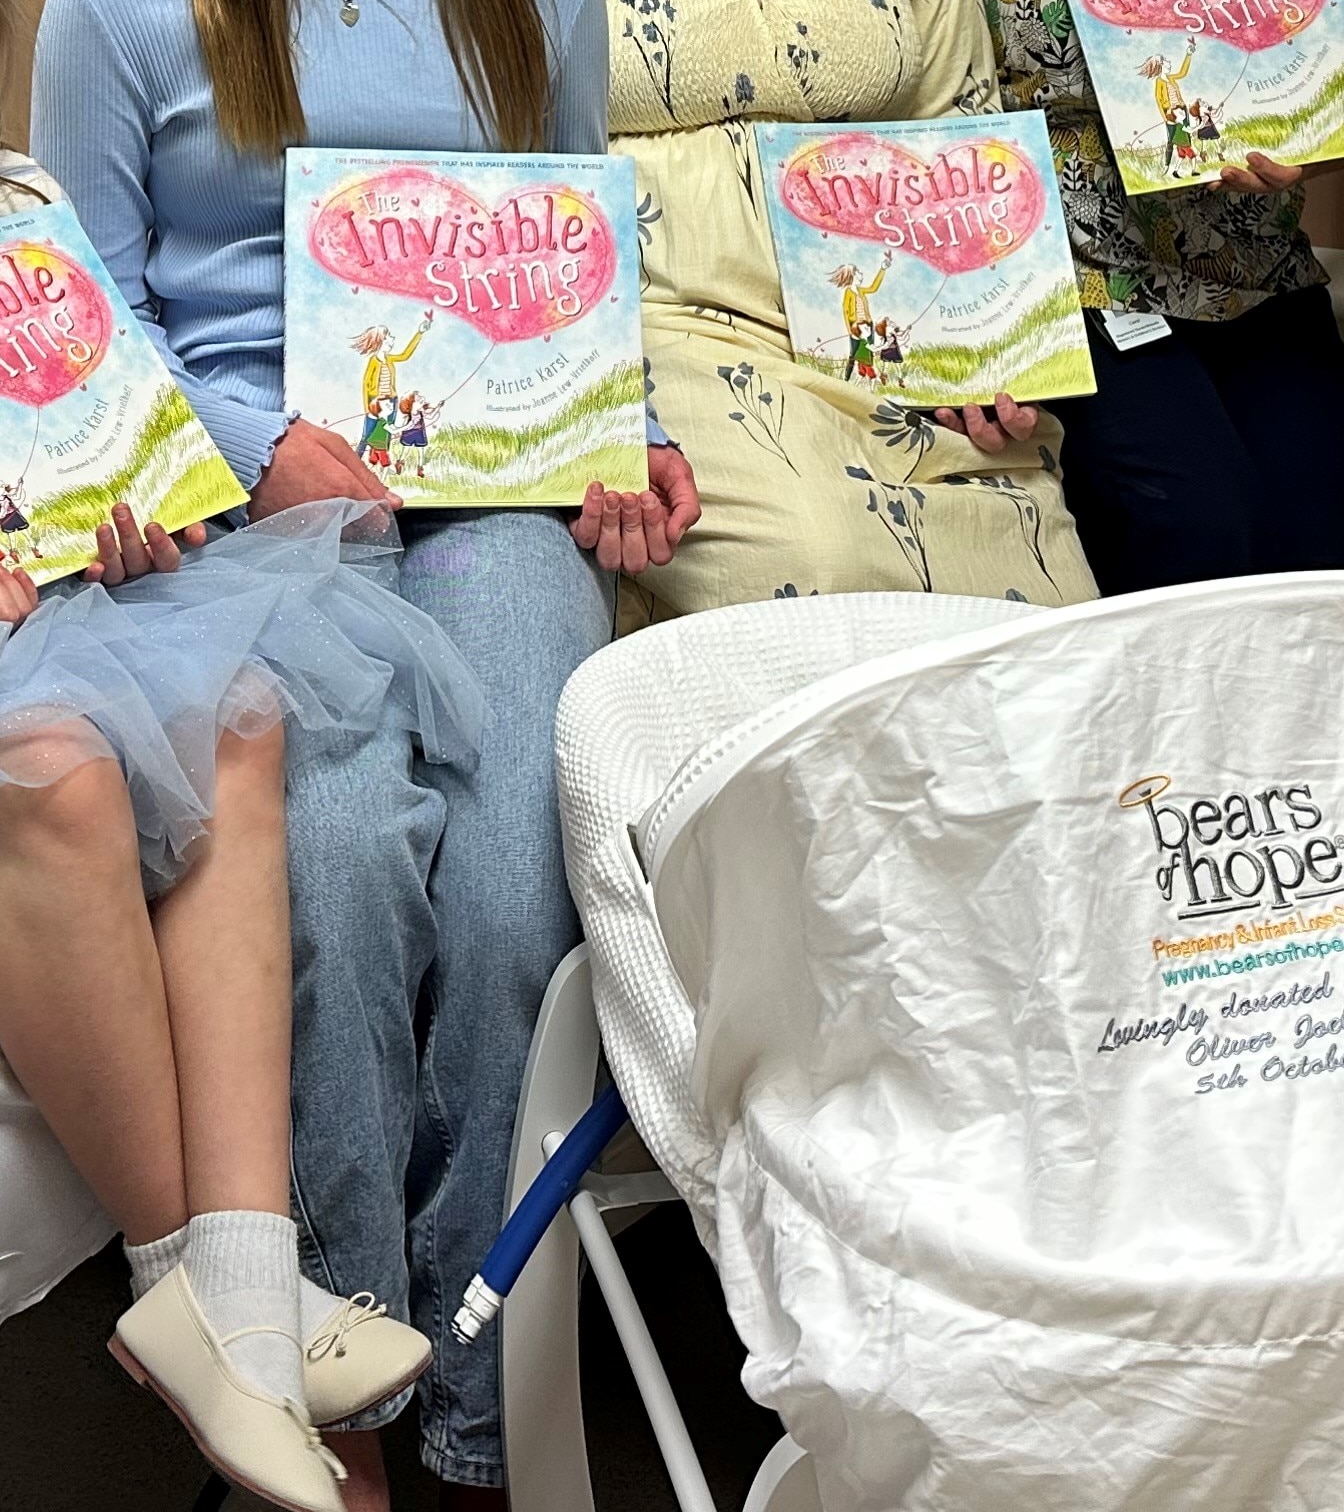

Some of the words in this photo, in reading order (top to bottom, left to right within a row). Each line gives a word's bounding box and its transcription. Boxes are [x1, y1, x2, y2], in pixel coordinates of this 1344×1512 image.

[1247, 73, 1286, 92] Patrice
[1282, 51, 1308, 76] Karst
[796, 146, 1012, 218] Invisible
[809, 153, 847, 174] The
[356, 191, 401, 217] The
[873, 195, 1015, 251] String
[341, 194, 588, 269] Invisible
[424, 255, 584, 317] String
[939, 300, 981, 318] Patrice
[981, 278, 1010, 304] Karst
[486, 377, 534, 395] Patrice
[536, 351, 570, 382] Karst
[44, 429, 89, 459] Patrice
[83, 397, 109, 430] Karst
[1139, 785, 1322, 852] bears
[1156, 852, 1181, 901] of
[1152, 932, 1234, 961] Pregnancy
[1235, 924, 1252, 945] &
[1251, 915, 1297, 942] Infant
[1296, 911, 1335, 933] Loss
[1097, 1002, 1209, 1053] Lovingly
[1221, 971, 1334, 1019] donated
[1185, 1031, 1277, 1066] Oliver
[1195, 1063, 1249, 1095] 5th
